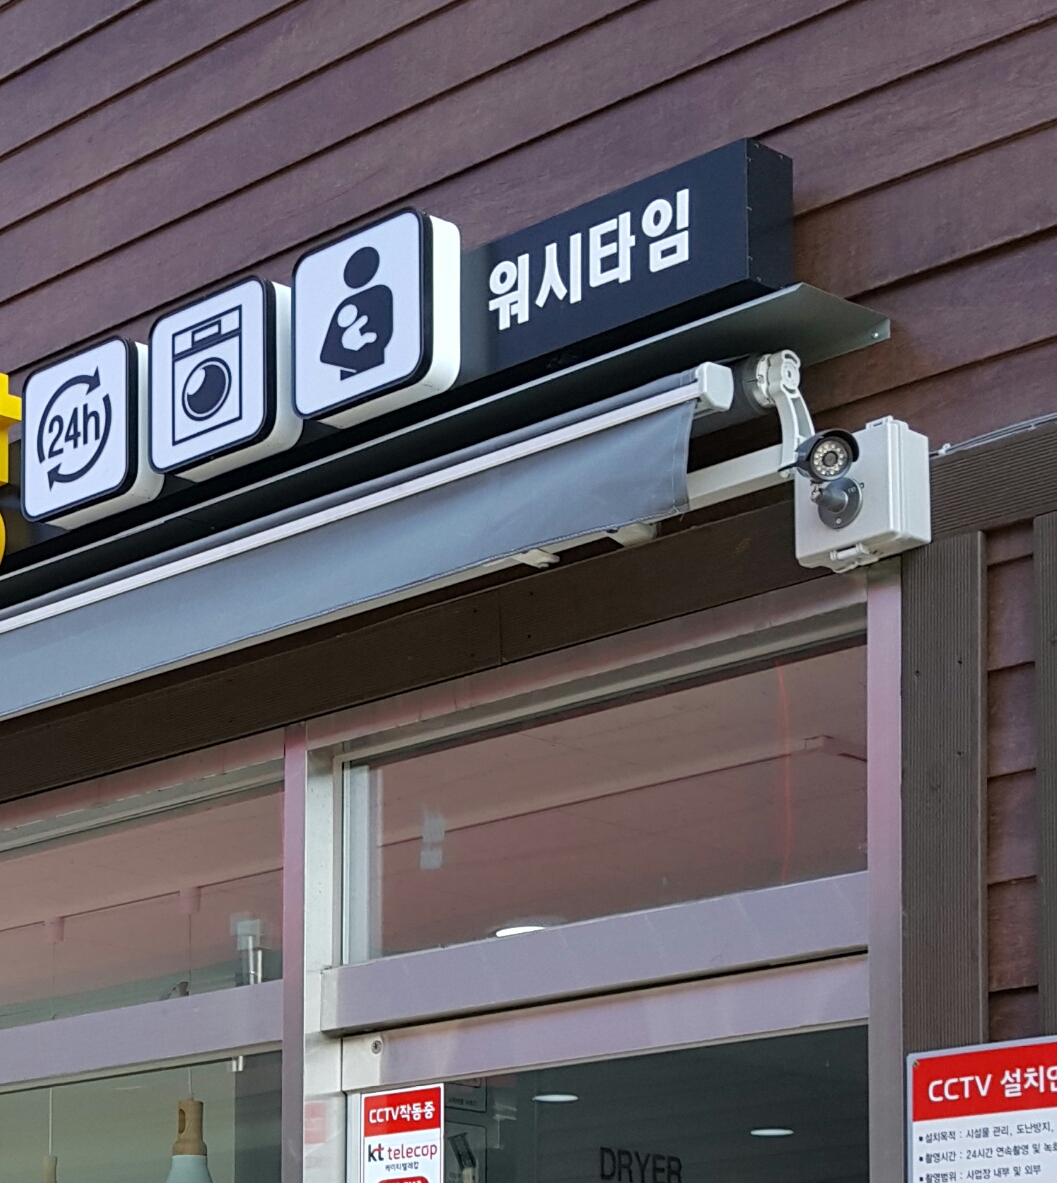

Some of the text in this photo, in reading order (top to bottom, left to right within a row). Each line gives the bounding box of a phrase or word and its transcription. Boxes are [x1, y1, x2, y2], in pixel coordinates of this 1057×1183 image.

[488, 188, 690, 331] 워시타임
[48, 402, 101, 461] 24h
[928, 1073, 992, 1103] CCTV
[369, 1101, 435, 1124] CCTV작동중
[925, 1131, 956, 1143] 설치목적
[966, 1127, 989, 1138] 시설물
[368, 1143, 437, 1162] kt telecop
[925, 1151, 956, 1164] 촬영시간
[966, 1147, 993, 1160] 24시간
[996, 1144, 1029, 1157] 연속촬영
[1032, 1143, 1041, 1154] 및
[925, 1164, 1041, 1183] 촬영범위 사업장 내부 및 외부
